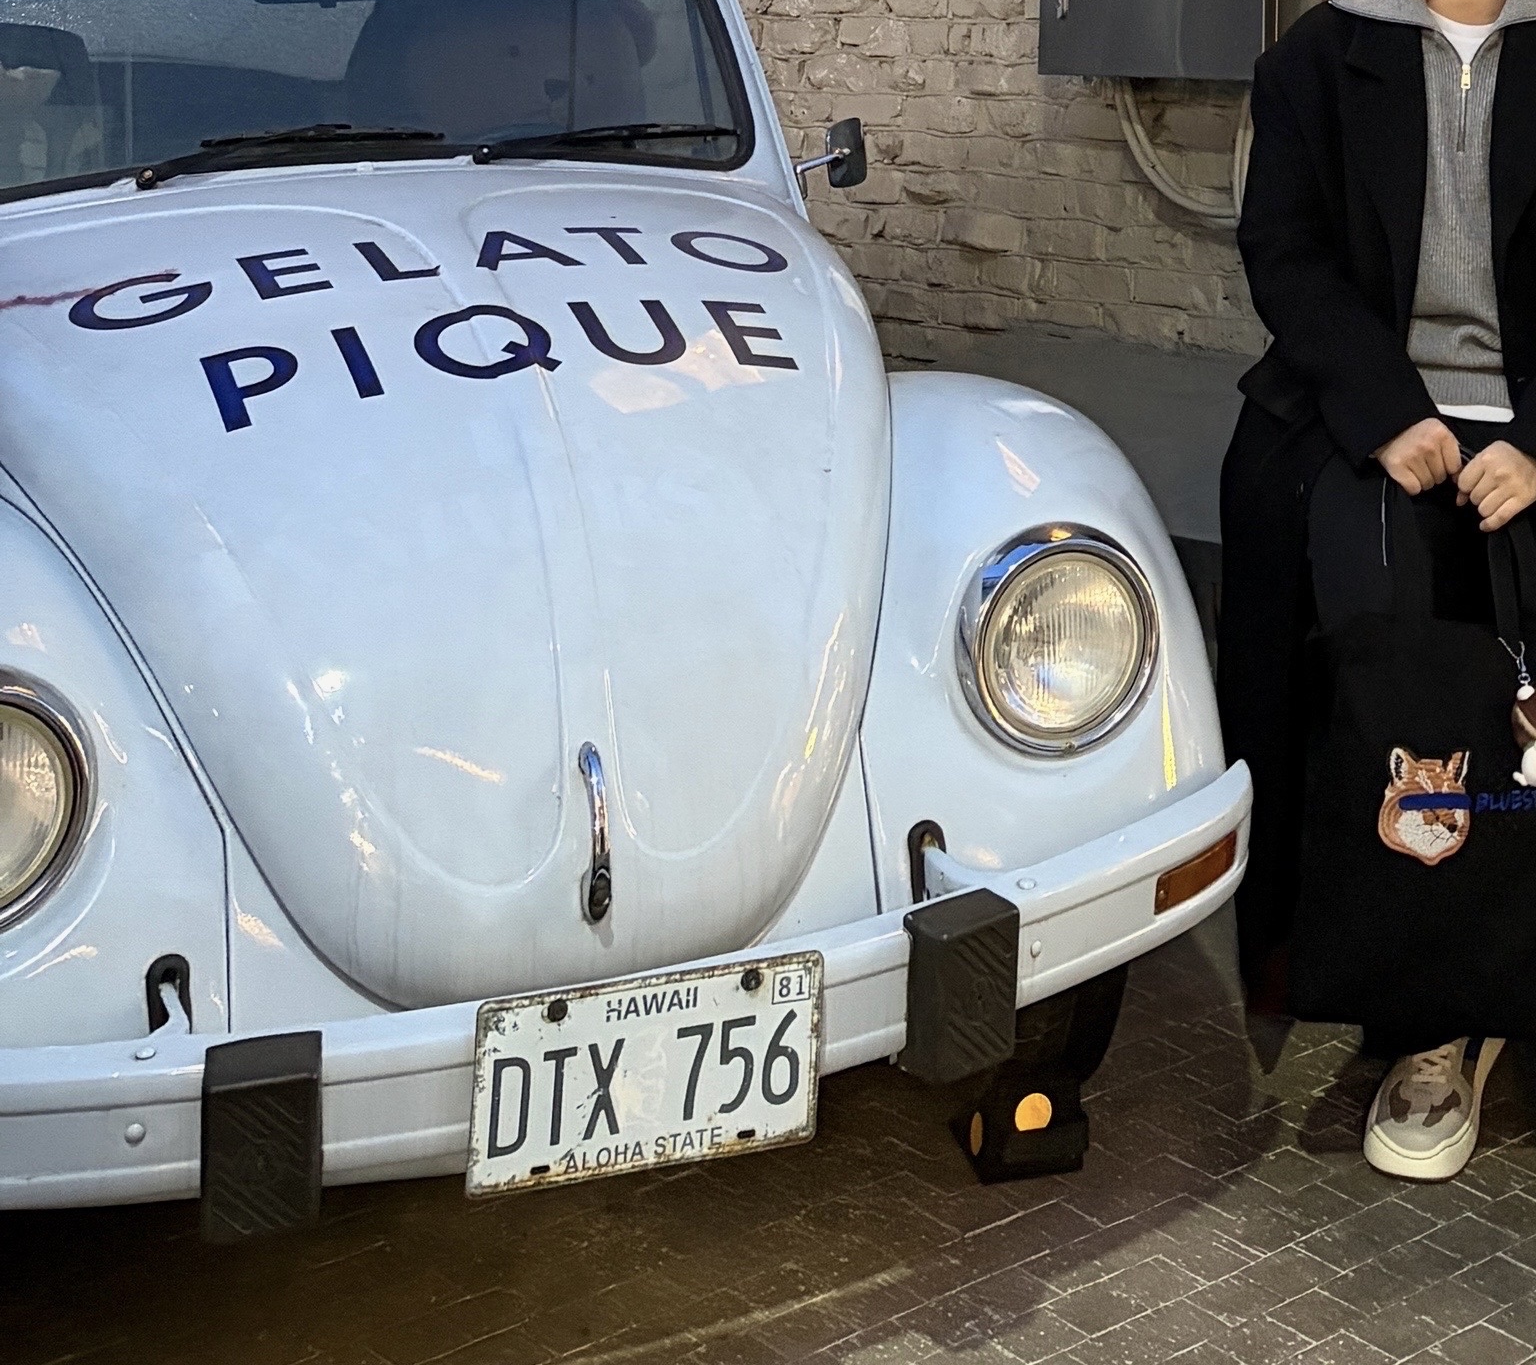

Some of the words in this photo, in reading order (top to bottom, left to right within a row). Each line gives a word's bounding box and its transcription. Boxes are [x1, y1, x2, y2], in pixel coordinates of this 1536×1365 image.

[68, 226, 789, 330] GELATO
[199, 299, 799, 433] PIQUE
[605, 986, 699, 1023] HAWAII
[777, 974, 806, 998] 81
[487, 1038, 625, 1159] DTX
[676, 1008, 800, 1121] 756
[565, 1141, 645, 1174] ALOHA
[654, 1125, 723, 1156] STATE
